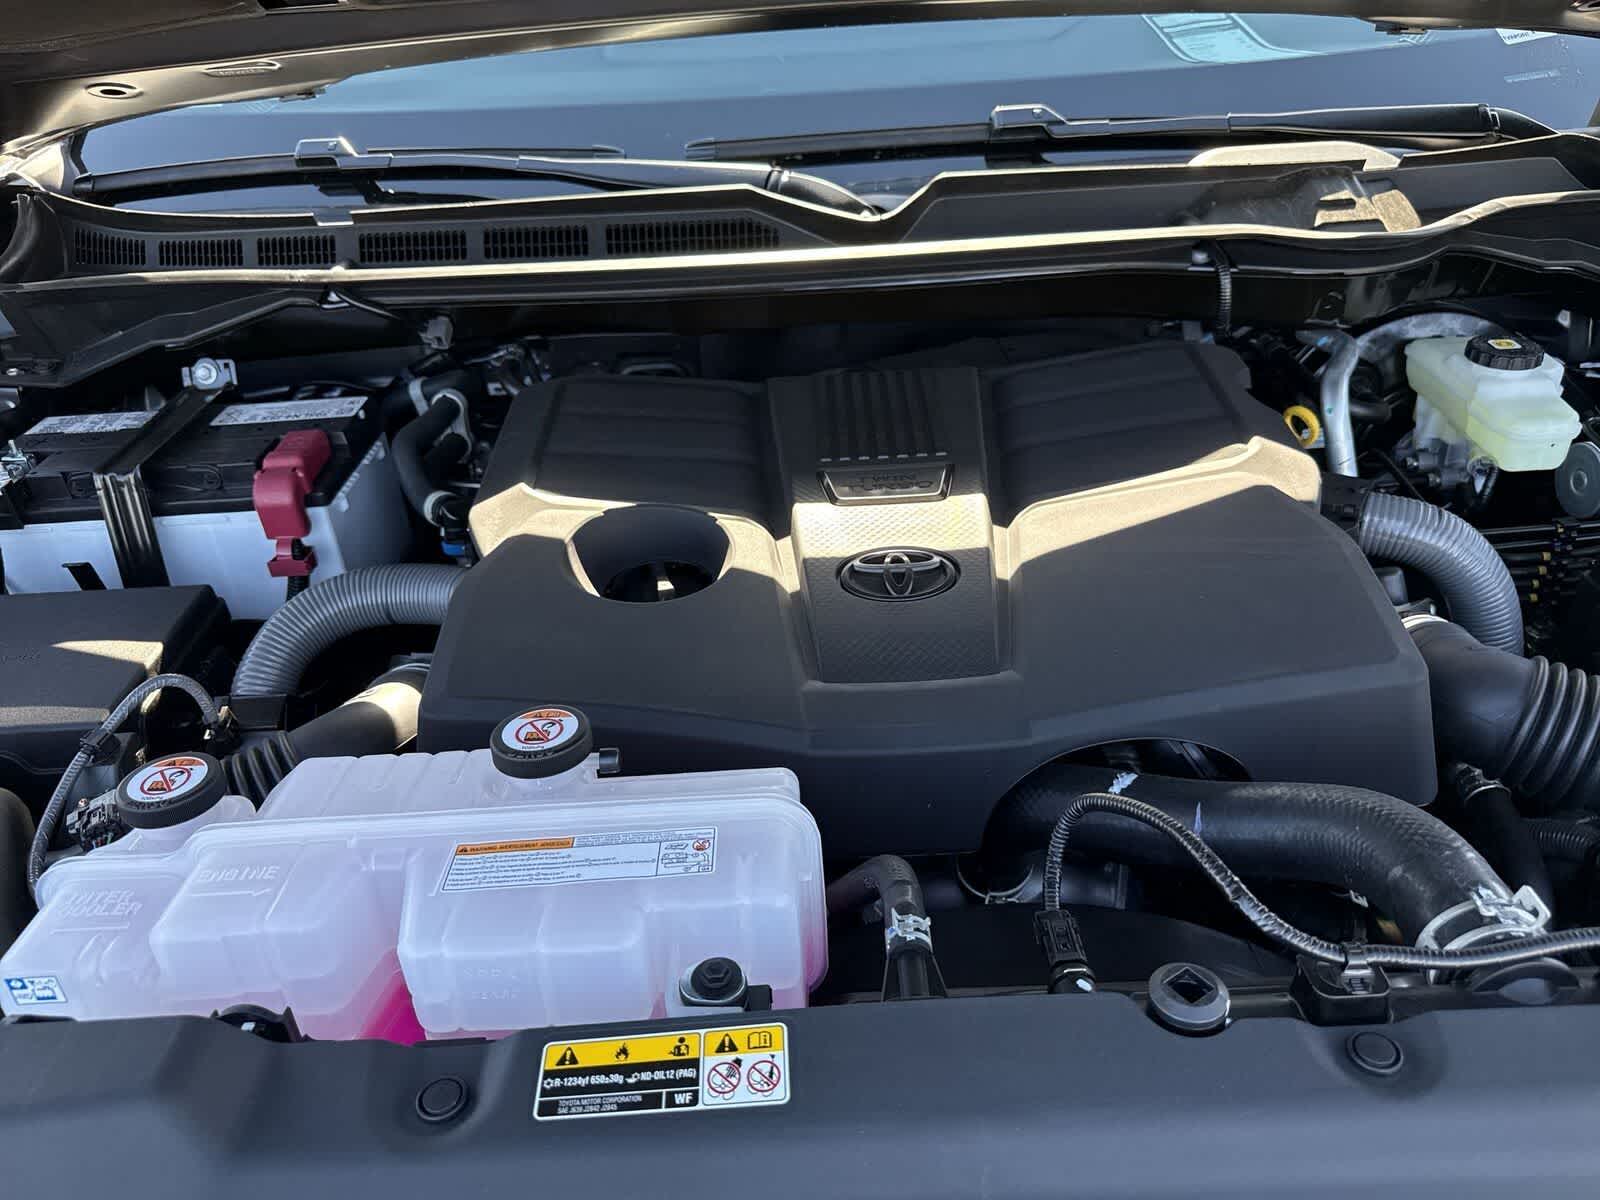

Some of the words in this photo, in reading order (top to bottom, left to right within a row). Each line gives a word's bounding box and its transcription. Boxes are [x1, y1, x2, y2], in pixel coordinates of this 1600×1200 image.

[199, 865, 281, 882] ENGINE
[554, 1076, 590, 1088] R-1234yf
[675, 1068, 697, 1080] (PAG)
[558, 1098, 581, 1107] TOYOTA
[580, 1096, 602, 1106] MOTOR
[602, 1094, 643, 1104] CORPORATION
[674, 1092, 694, 1105] WF
[557, 1105, 569, 1114] SAE
